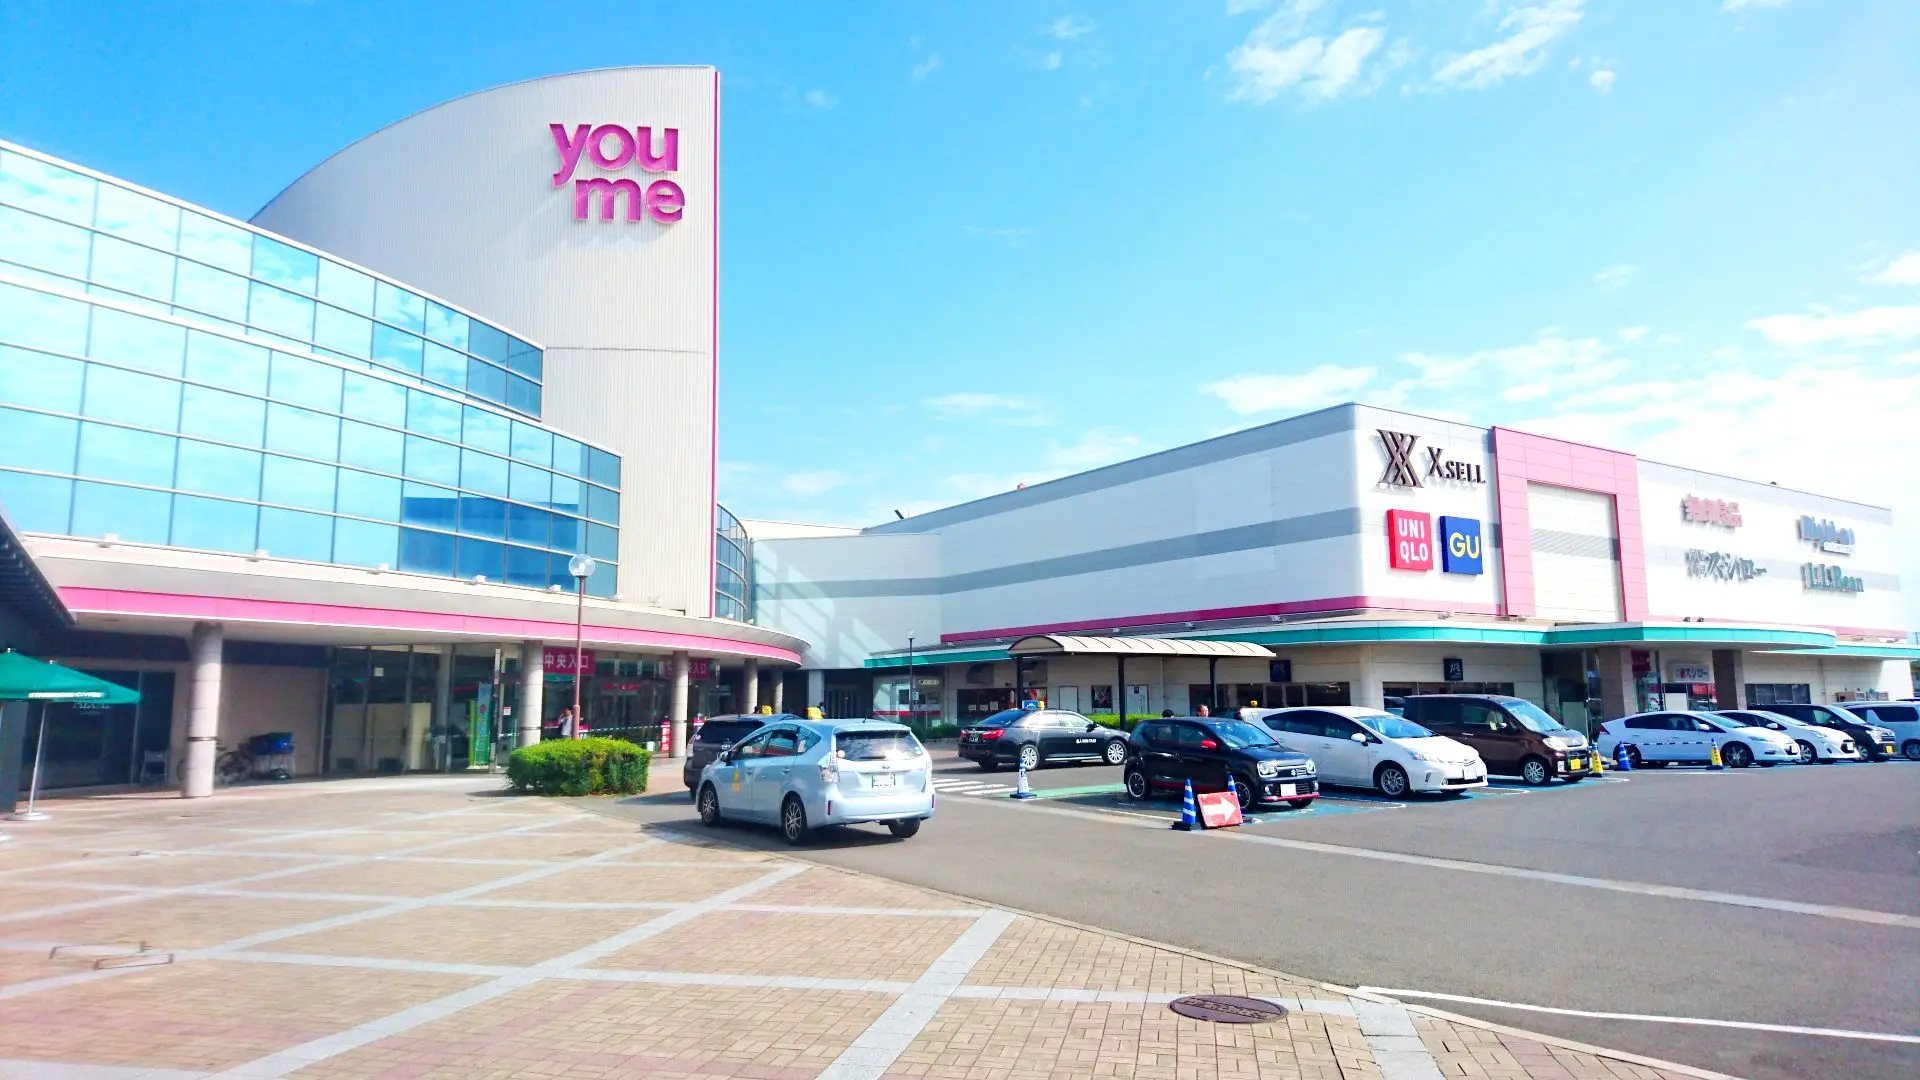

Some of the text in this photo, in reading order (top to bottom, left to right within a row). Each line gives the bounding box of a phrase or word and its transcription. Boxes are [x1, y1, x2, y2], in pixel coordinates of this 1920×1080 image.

[549, 123, 679, 189] you
[575, 177, 686, 224] me
[1398, 517, 1425, 539] UNI
[1400, 541, 1429, 563] QLO
[1450, 532, 1480, 559] GU
[543, 653, 589, 670] 中央入口
